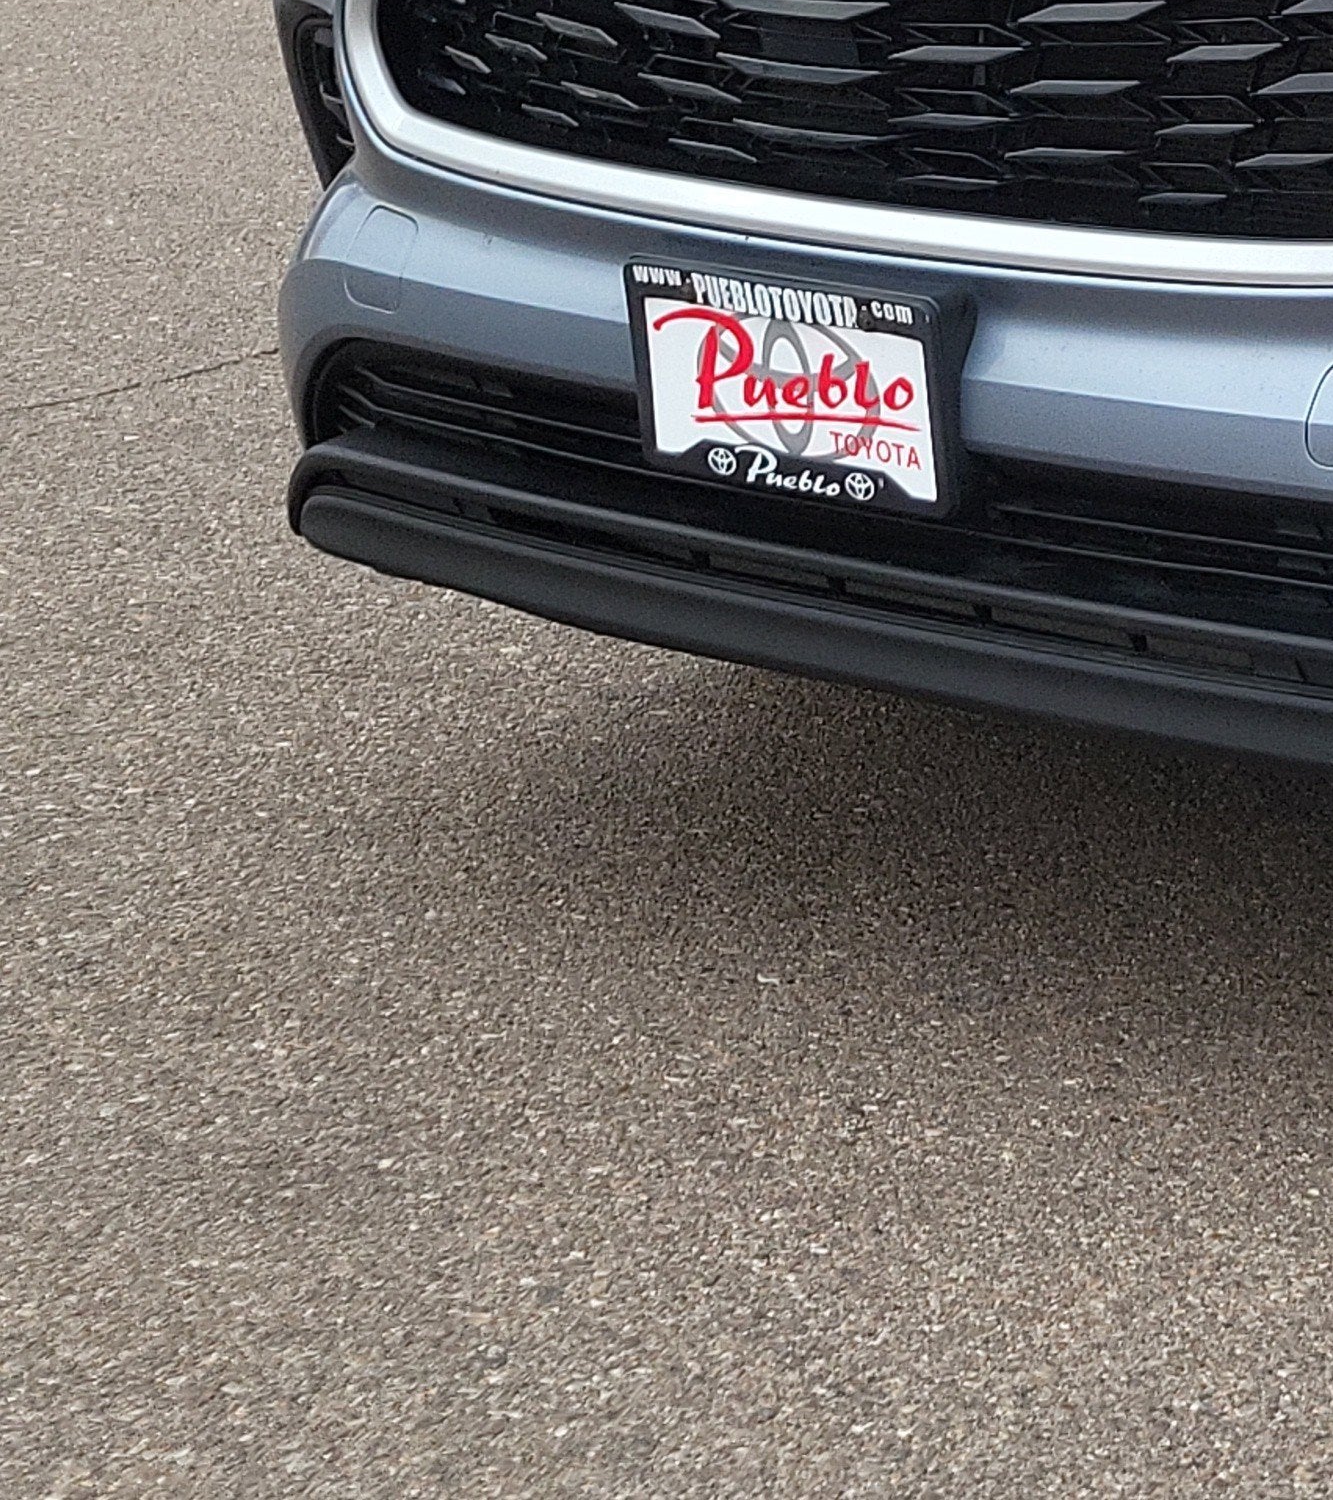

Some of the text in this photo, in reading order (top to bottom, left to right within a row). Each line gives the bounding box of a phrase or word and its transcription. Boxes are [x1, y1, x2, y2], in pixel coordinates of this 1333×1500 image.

[652, 308, 914, 411] Pueblo
[734, 445, 841, 497] Pueblo
[829, 431, 922, 471] TOYOTA
